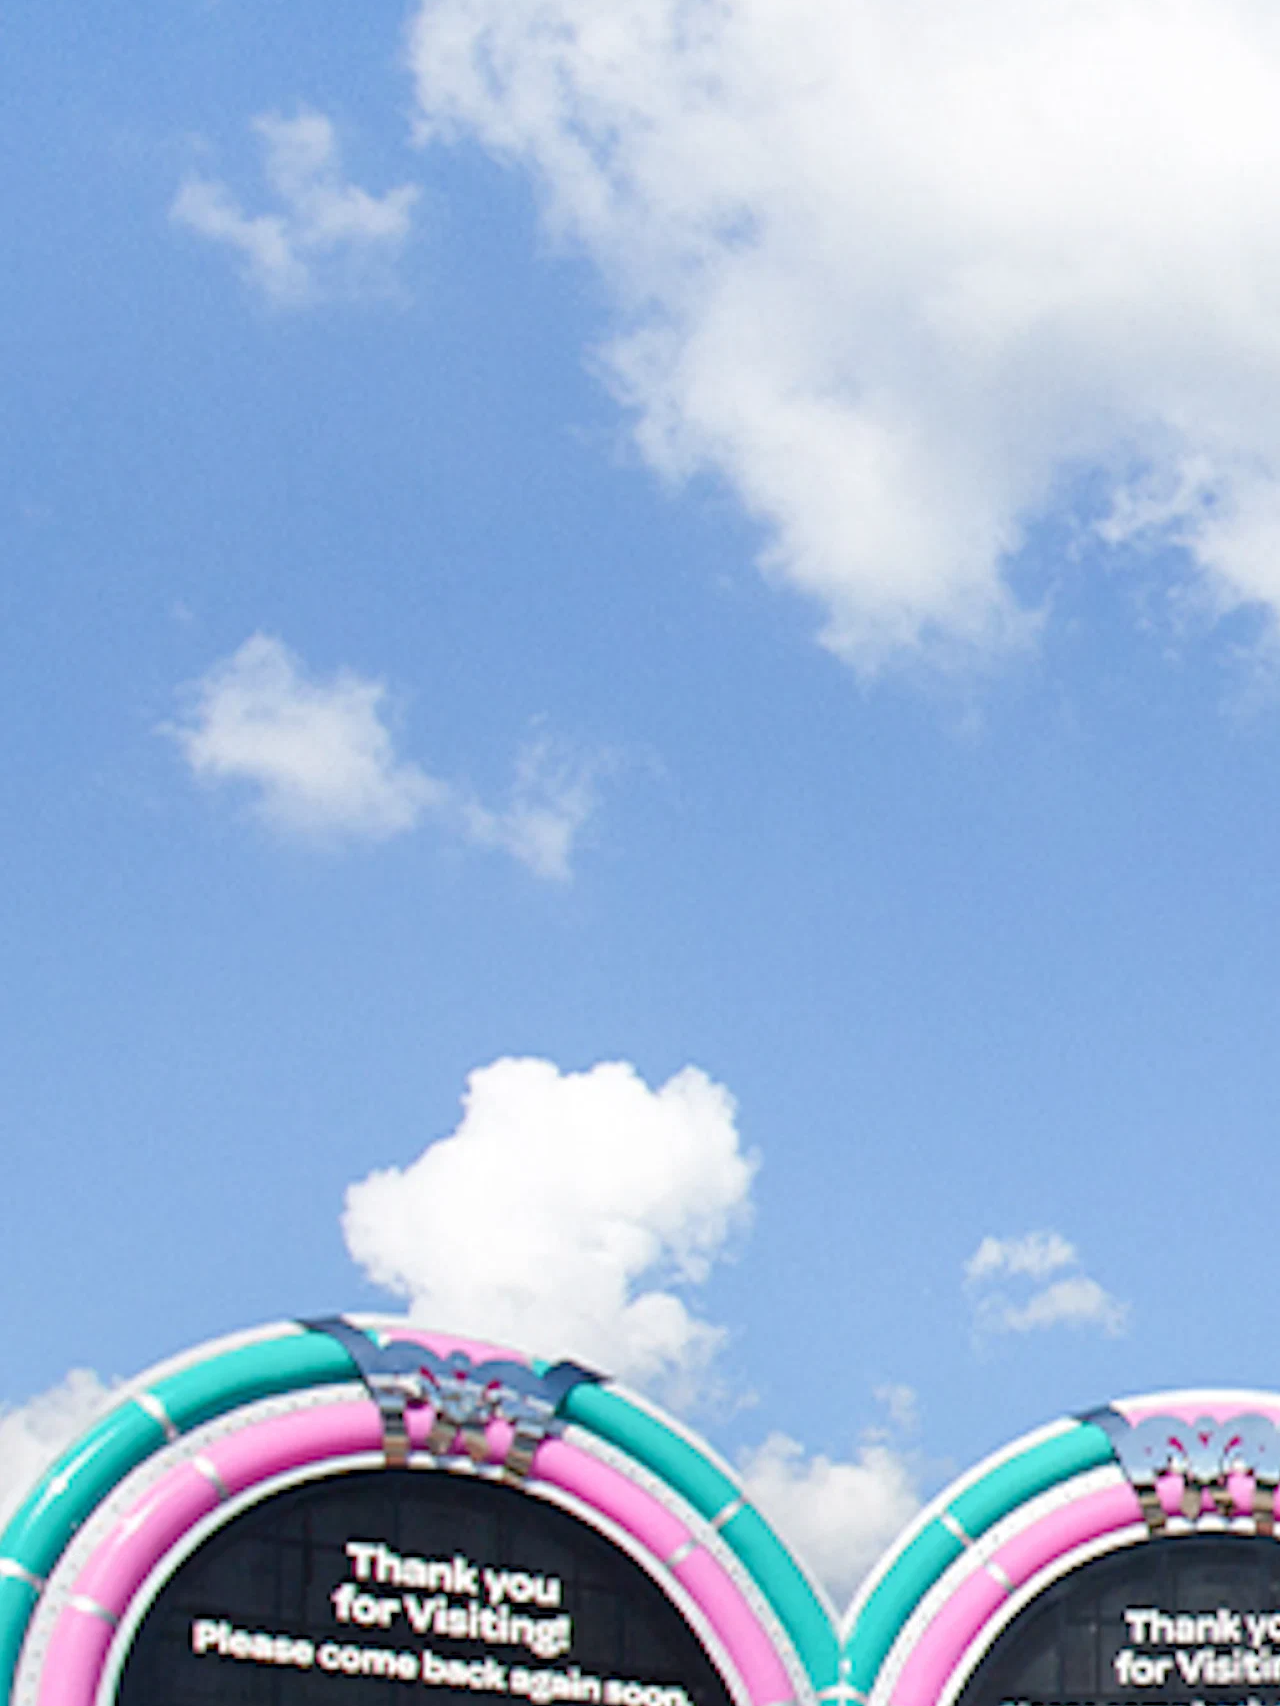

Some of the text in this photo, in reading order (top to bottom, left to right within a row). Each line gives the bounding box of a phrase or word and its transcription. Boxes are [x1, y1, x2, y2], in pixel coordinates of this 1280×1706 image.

[345, 1541, 561, 1607] Thank you
[332, 1583, 572, 1658] for Visiting!
[1125, 1606, 1243, 1645] Thank
[193, 1618, 313, 1667] Please
[316, 1638, 417, 1681] come
[421, 1648, 508, 1691] back
[510, 1664, 600, 1706] again
[1115, 1648, 1172, 1687] for
